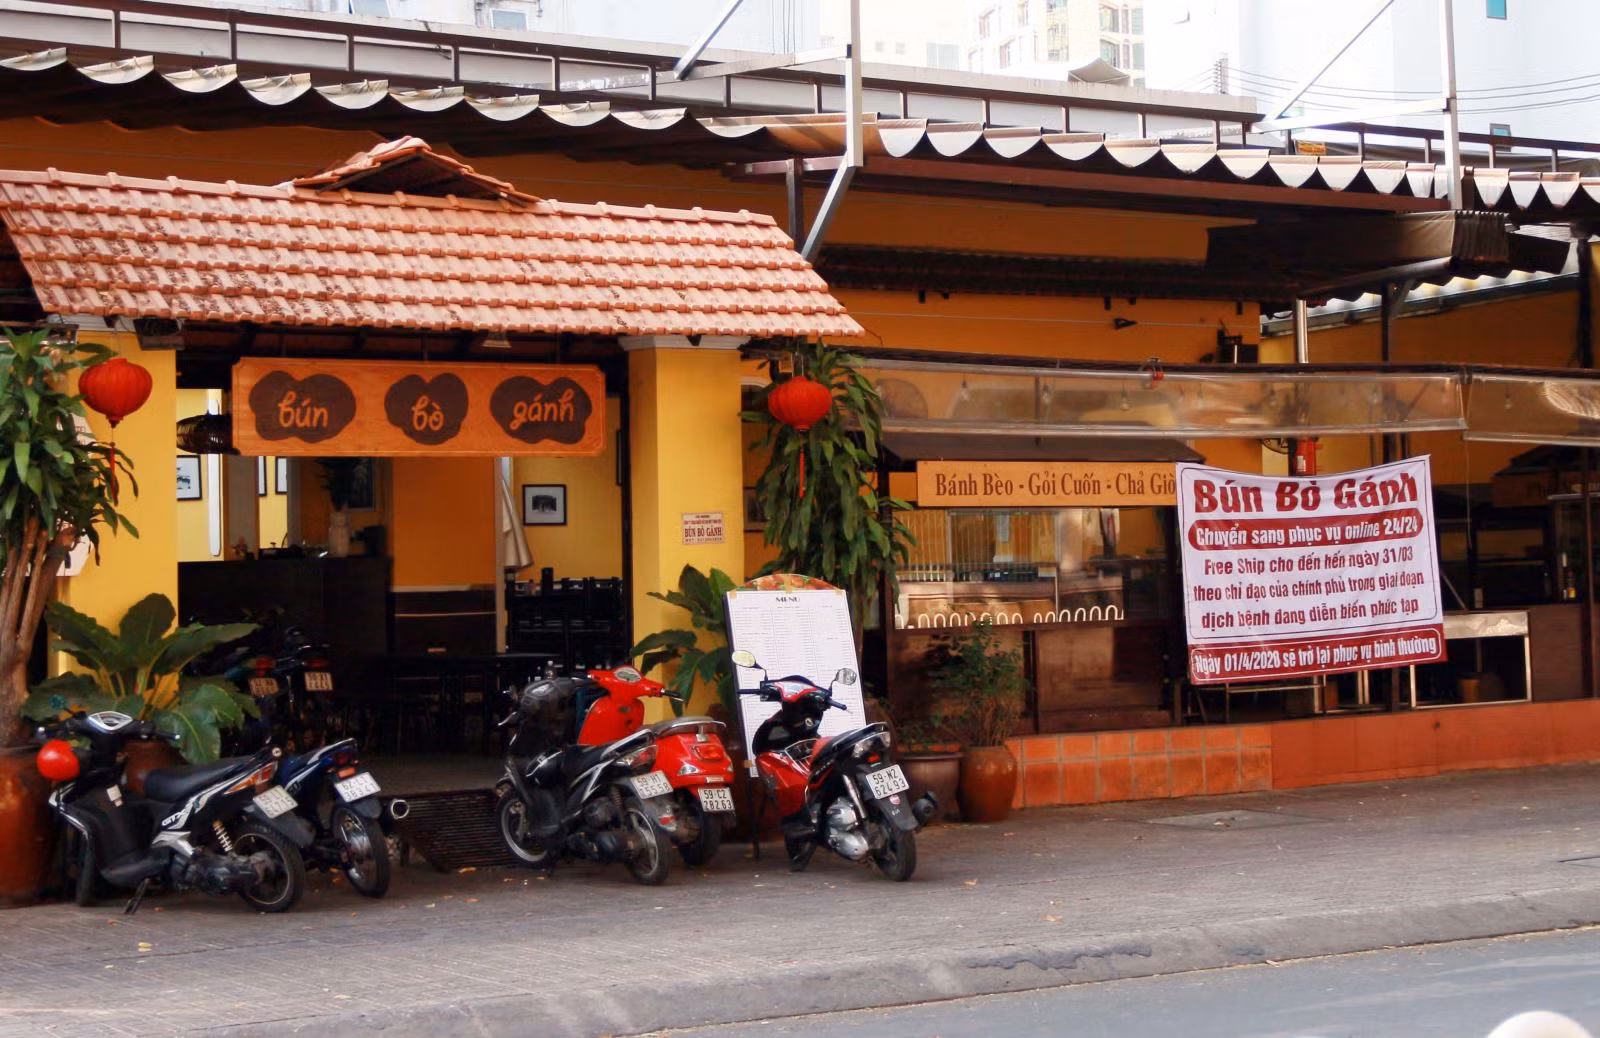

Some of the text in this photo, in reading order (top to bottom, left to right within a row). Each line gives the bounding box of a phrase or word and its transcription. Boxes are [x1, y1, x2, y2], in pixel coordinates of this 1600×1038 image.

[278, 388, 575, 431] bún bò gánh
[936, 470, 1176, 496] Bánh Bèo Gỏi Cuốn Chả Giò
[1193, 472, 1418, 513] Bún Bò Gánh
[1196, 515, 1418, 547] Chuyển sang phục vụ online 24/24
[1204, 546, 1413, 575] Free Ship cho đến hến ngày 31/03
[1194, 571, 1424, 602] theo chỉ đạo của chính phủ trong giai đoạn
[1201, 598, 1419, 632] dịch bệnh đang diễn biến phức tạp
[1195, 653, 1221, 675] Ngày
[1283, 648, 1296, 667] sẽ
[1298, 645, 1314, 666] trở
[1316, 646, 1331, 668] lại
[1333, 644, 1358, 665] phục
[1360, 644, 1372, 663] vụ
[1398, 635, 1437, 656] thường
